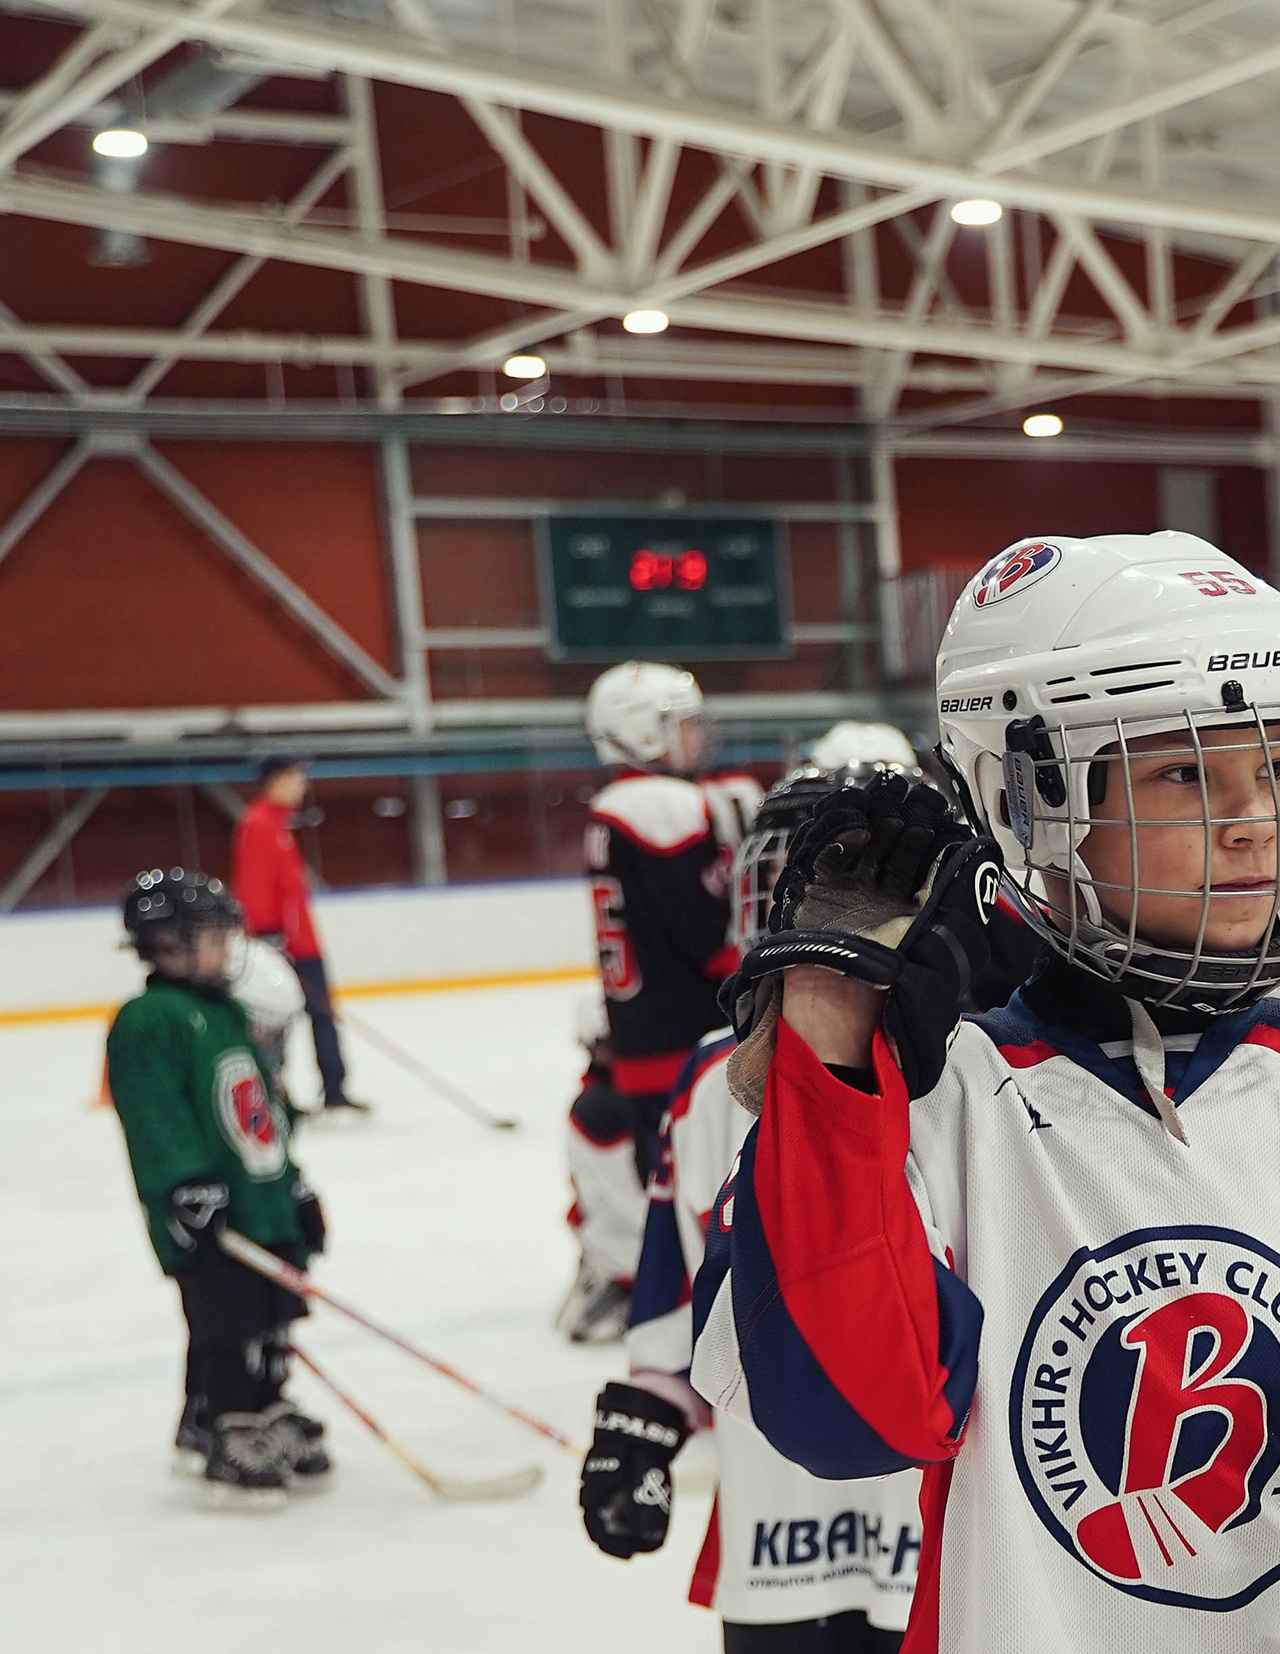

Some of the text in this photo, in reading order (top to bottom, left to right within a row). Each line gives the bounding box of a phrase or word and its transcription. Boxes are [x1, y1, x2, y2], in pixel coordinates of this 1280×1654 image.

[1178, 571, 1257, 597] 55
[940, 696, 994, 713] BAUER
[1059, 1251, 1208, 1342] HOCKEY
[1031, 1363, 1089, 1511] VIKHR
